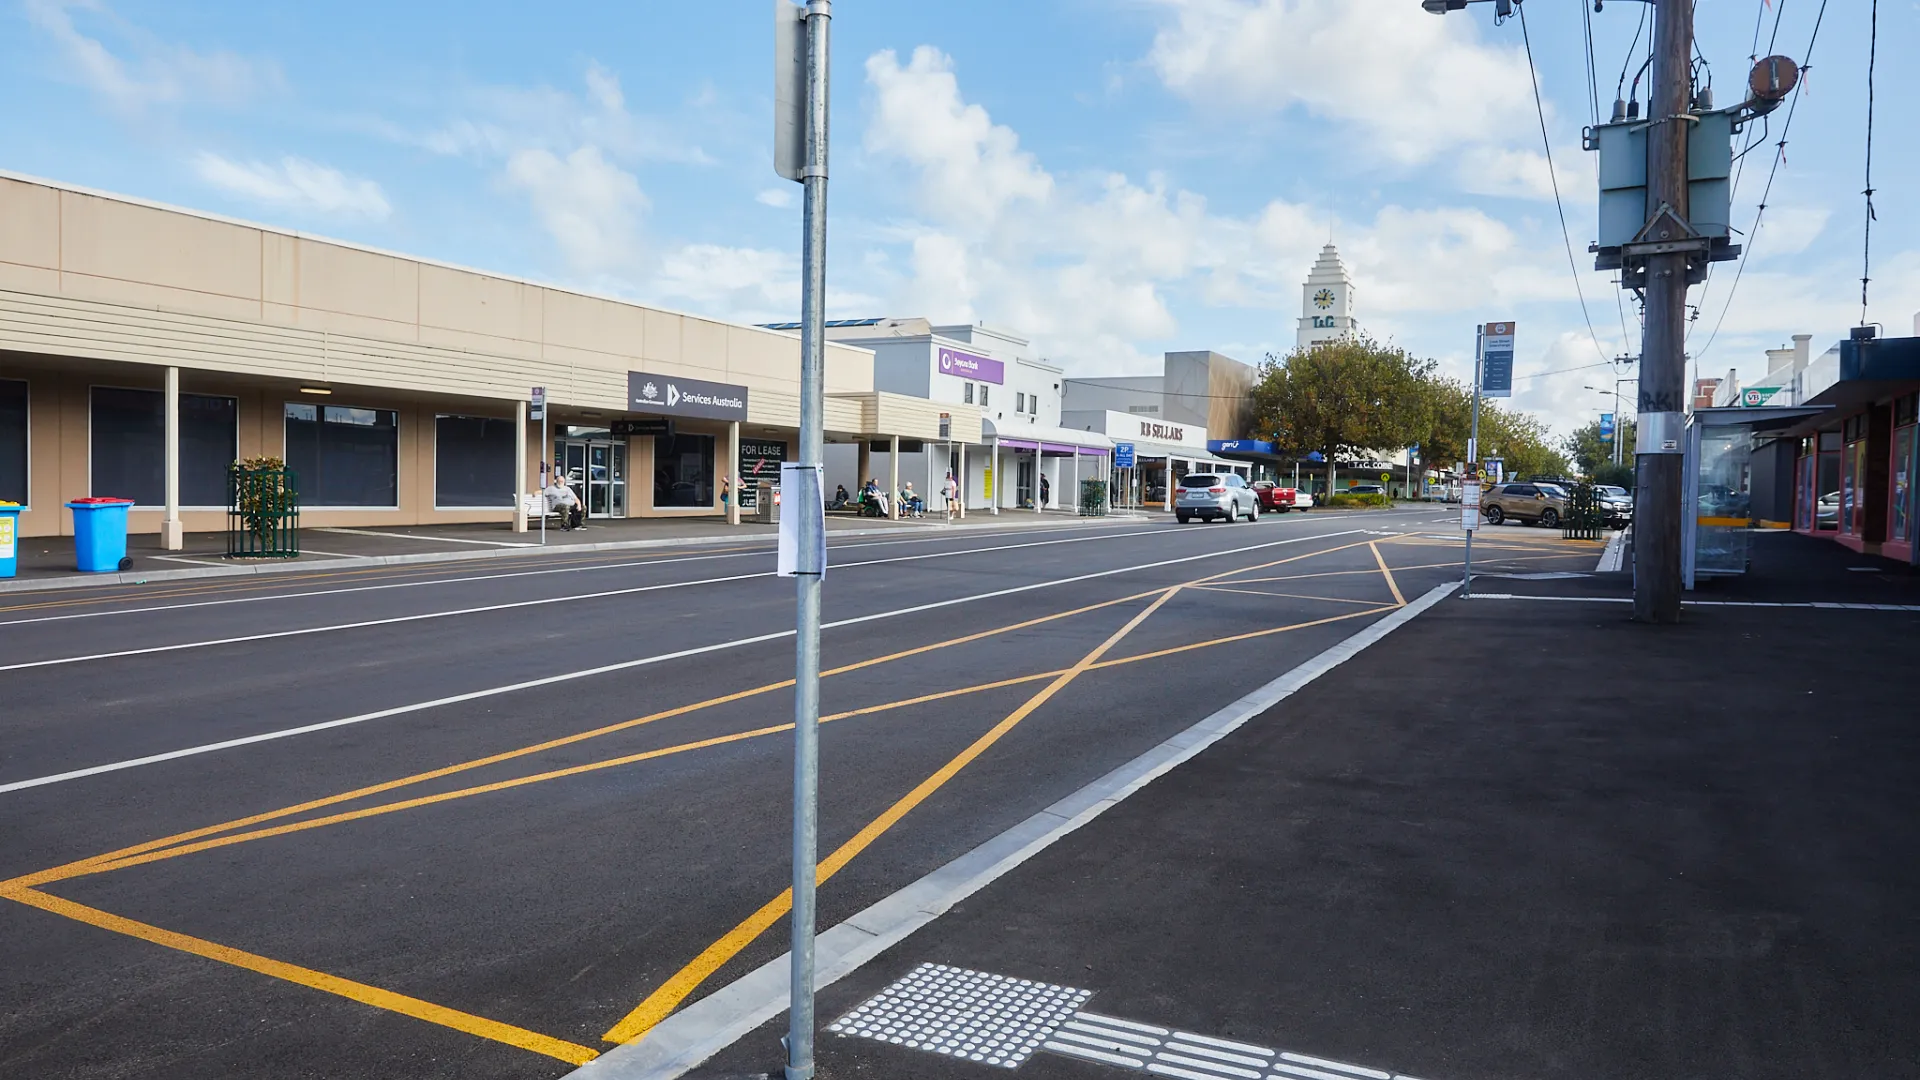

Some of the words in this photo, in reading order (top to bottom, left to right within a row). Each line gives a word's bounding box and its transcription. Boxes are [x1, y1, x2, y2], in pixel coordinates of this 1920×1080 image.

[1311, 315, 1335, 329] T&G
[682, 391, 712, 406] Services
[712, 395, 743, 409] Australia
[1140, 421, 1151, 437] RB
[1152, 423, 1183, 441] SELLARS
[741, 445, 757, 455] FOR
[758, 446, 781, 456] LEASE
